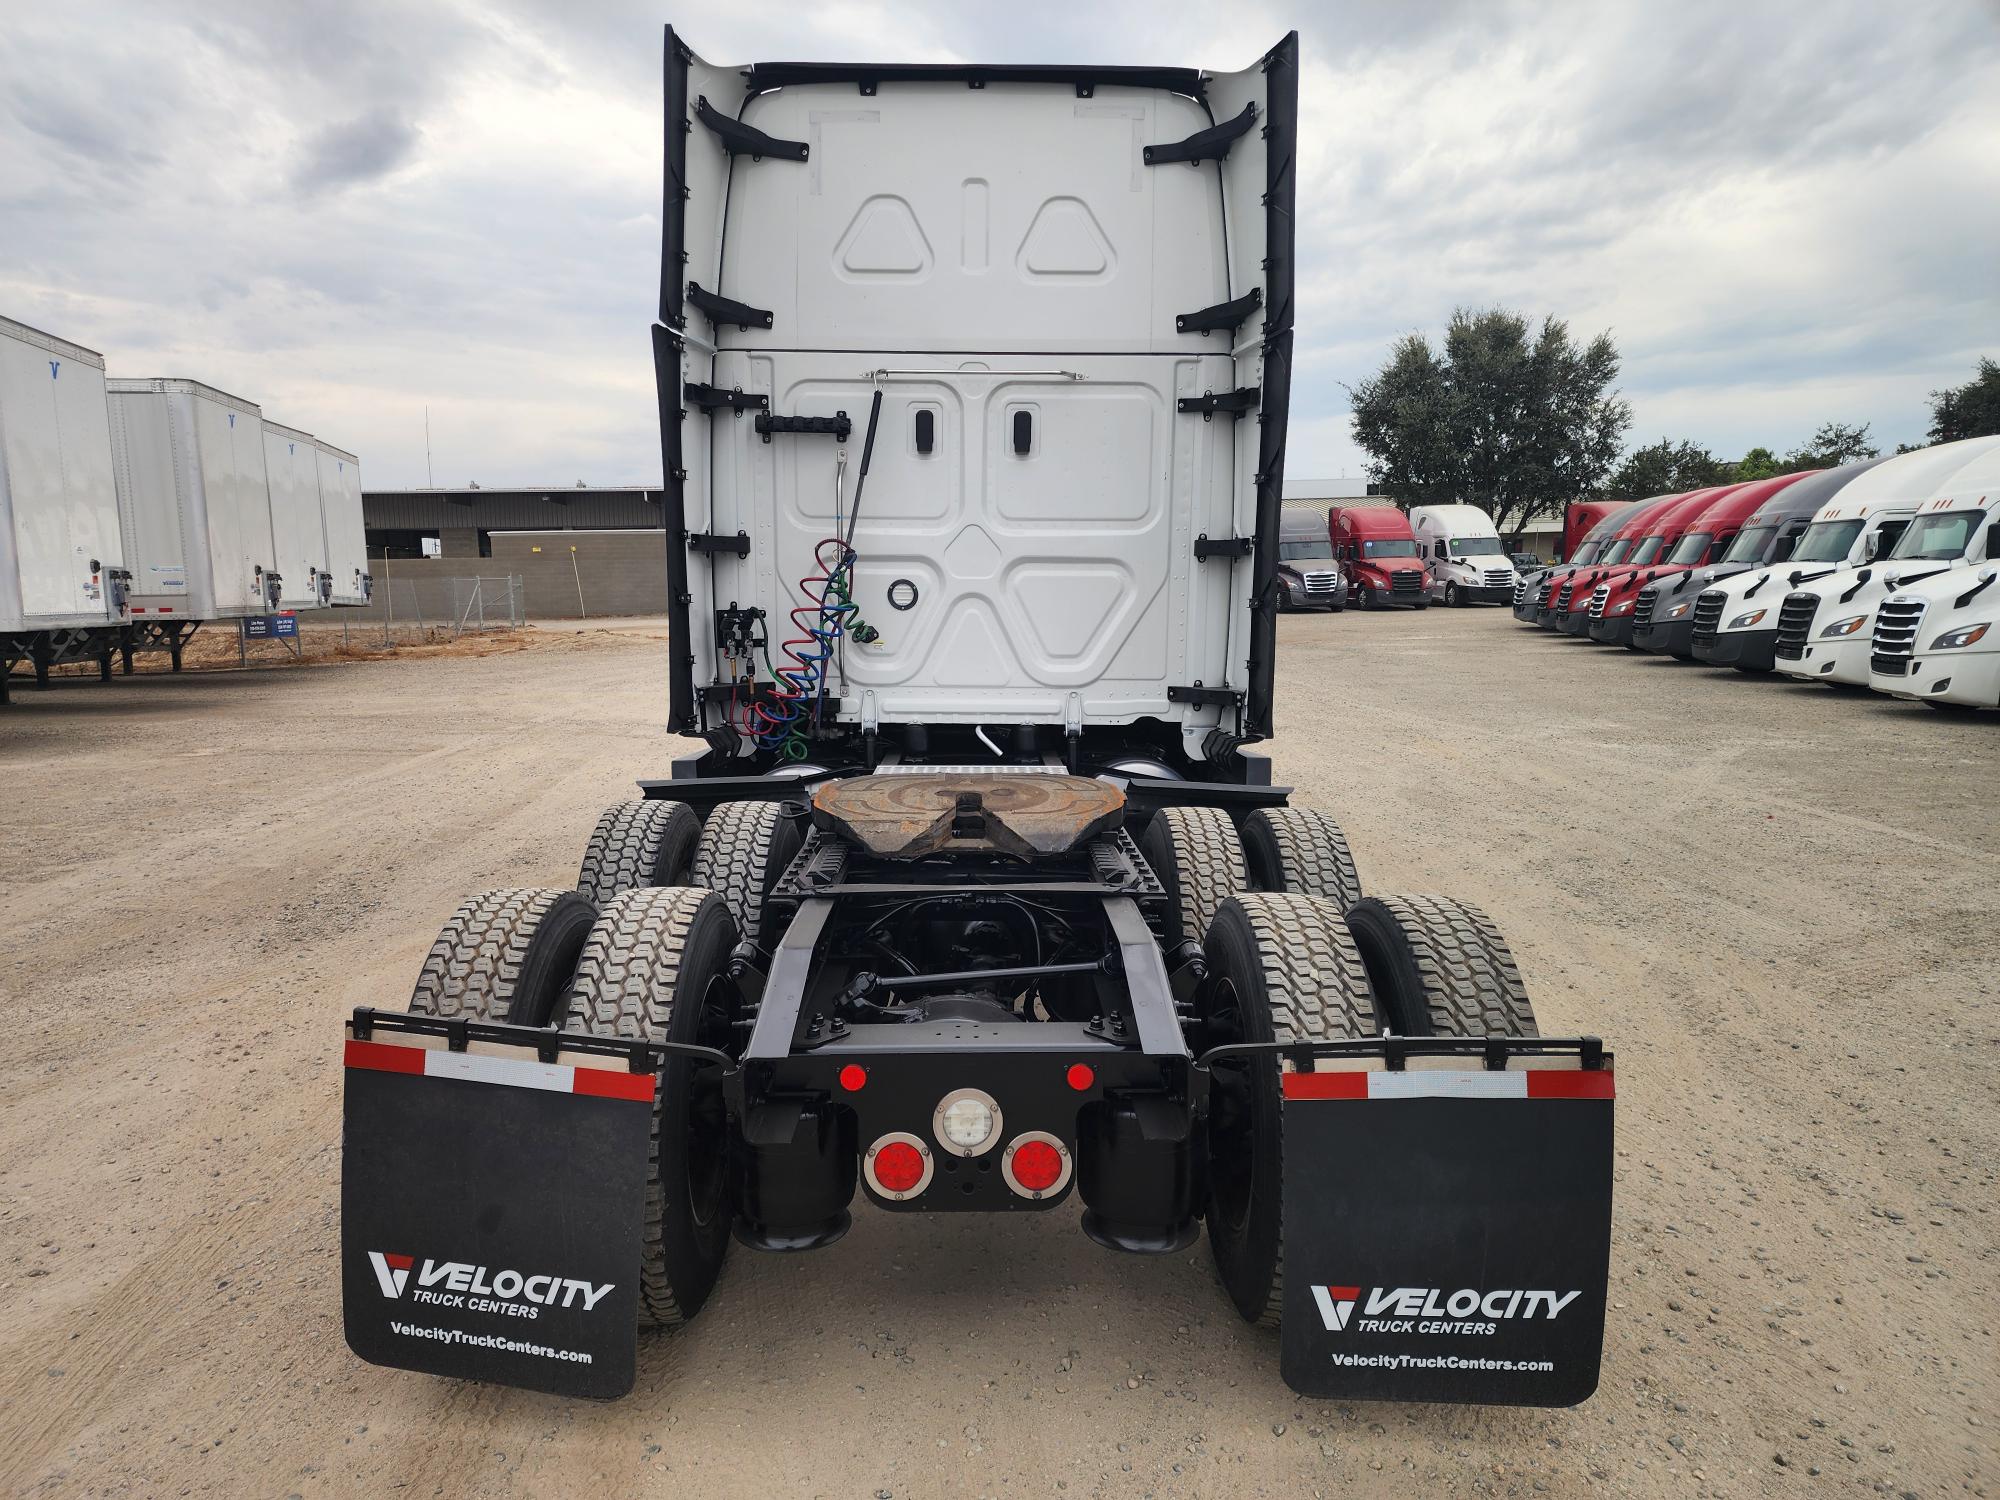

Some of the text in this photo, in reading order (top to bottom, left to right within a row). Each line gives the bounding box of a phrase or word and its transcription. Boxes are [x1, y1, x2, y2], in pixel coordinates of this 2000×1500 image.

[417, 1258, 616, 1311] VELOCITY
[412, 1289, 539, 1320] TRUCK CENTERS
[1363, 1287, 1582, 1320] VELOCITY
[390, 1321, 593, 1365] VelocityTruckCenters.com
[1357, 1319, 1497, 1336] TRUCK CENTERS
[1331, 1353, 1554, 1373] VelocityTruckCenters.com
